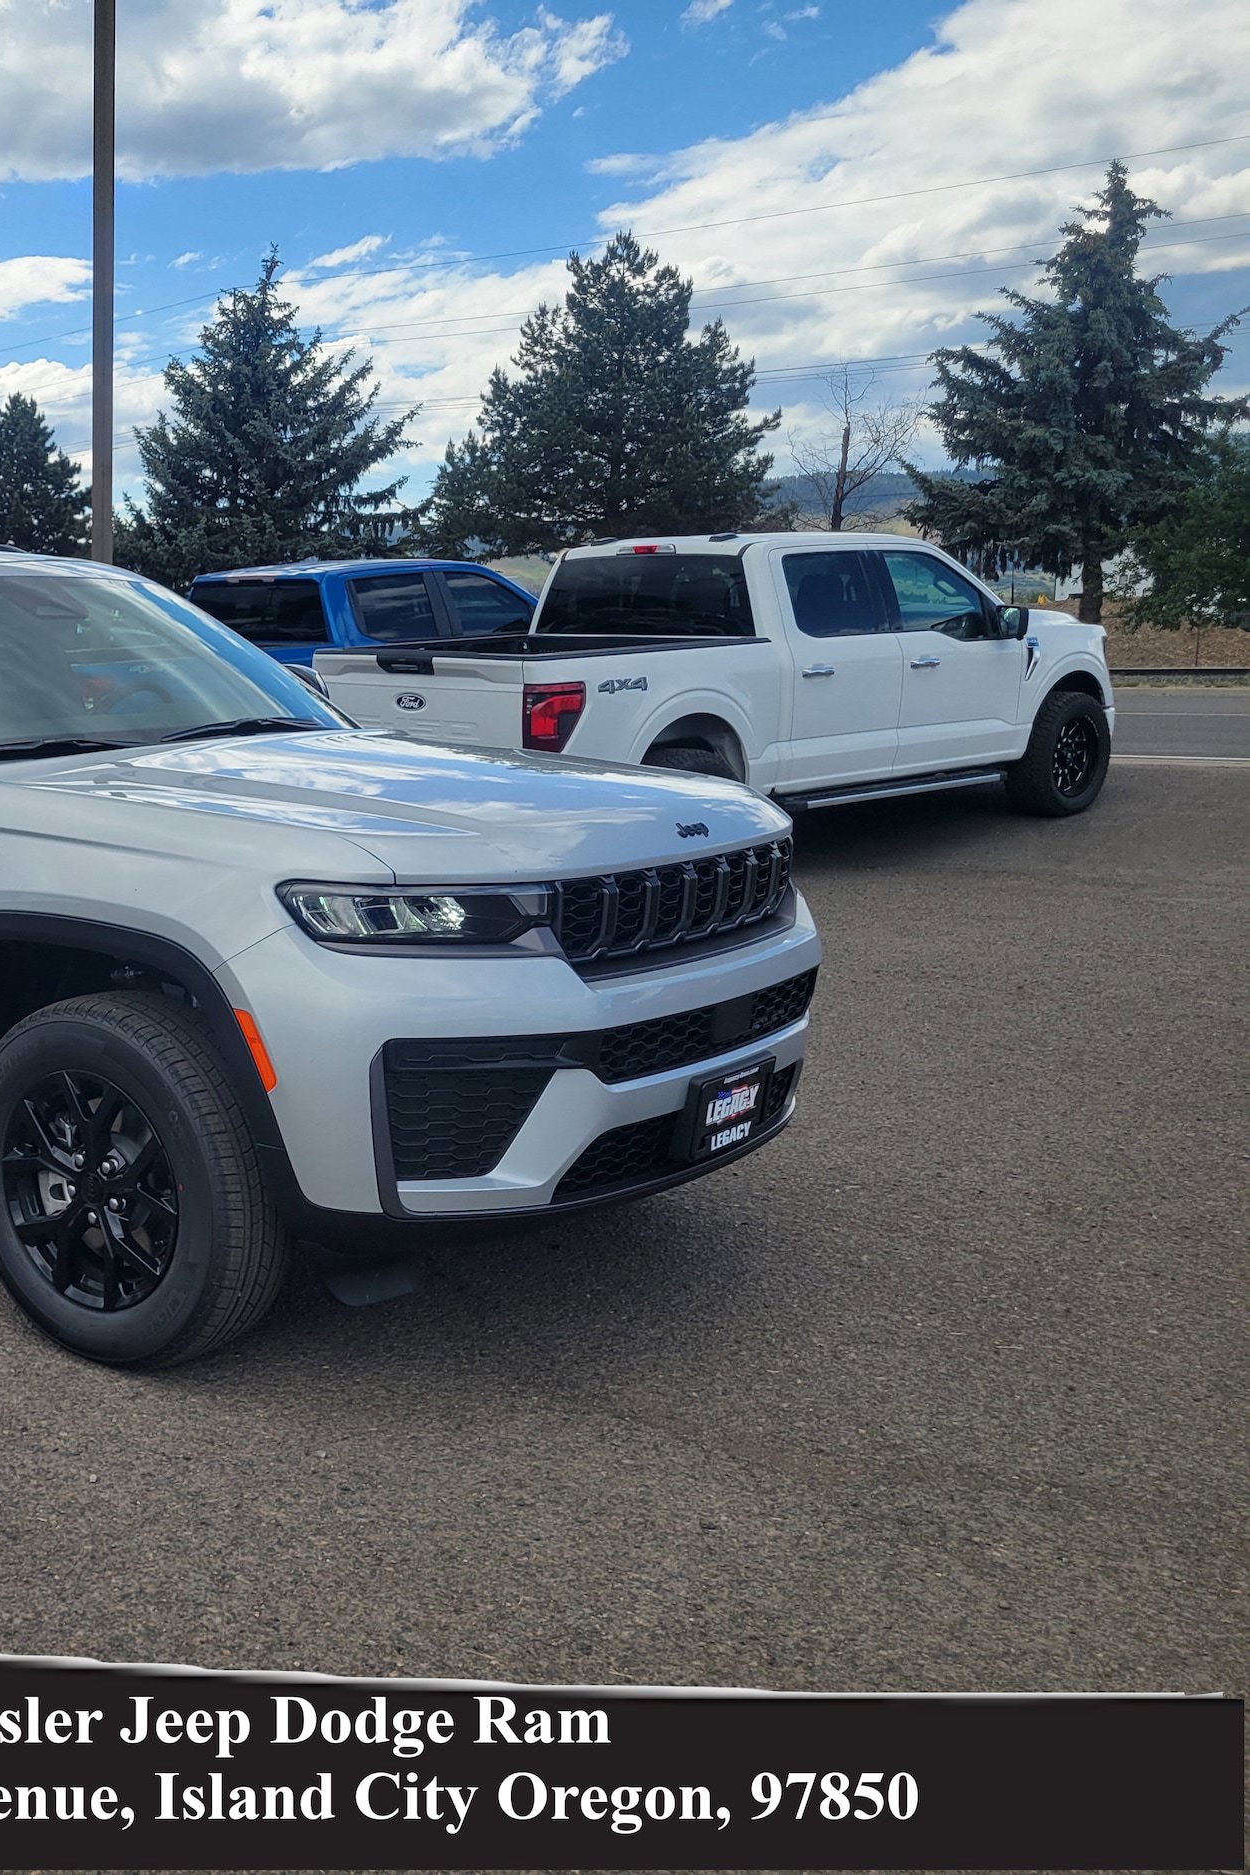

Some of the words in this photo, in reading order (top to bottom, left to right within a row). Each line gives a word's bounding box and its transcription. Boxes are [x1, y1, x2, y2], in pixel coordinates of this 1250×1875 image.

[675, 822, 710, 839] Jeep
[705, 1085, 760, 1126] LEGACY
[710, 1121, 752, 1151] LEGACY
